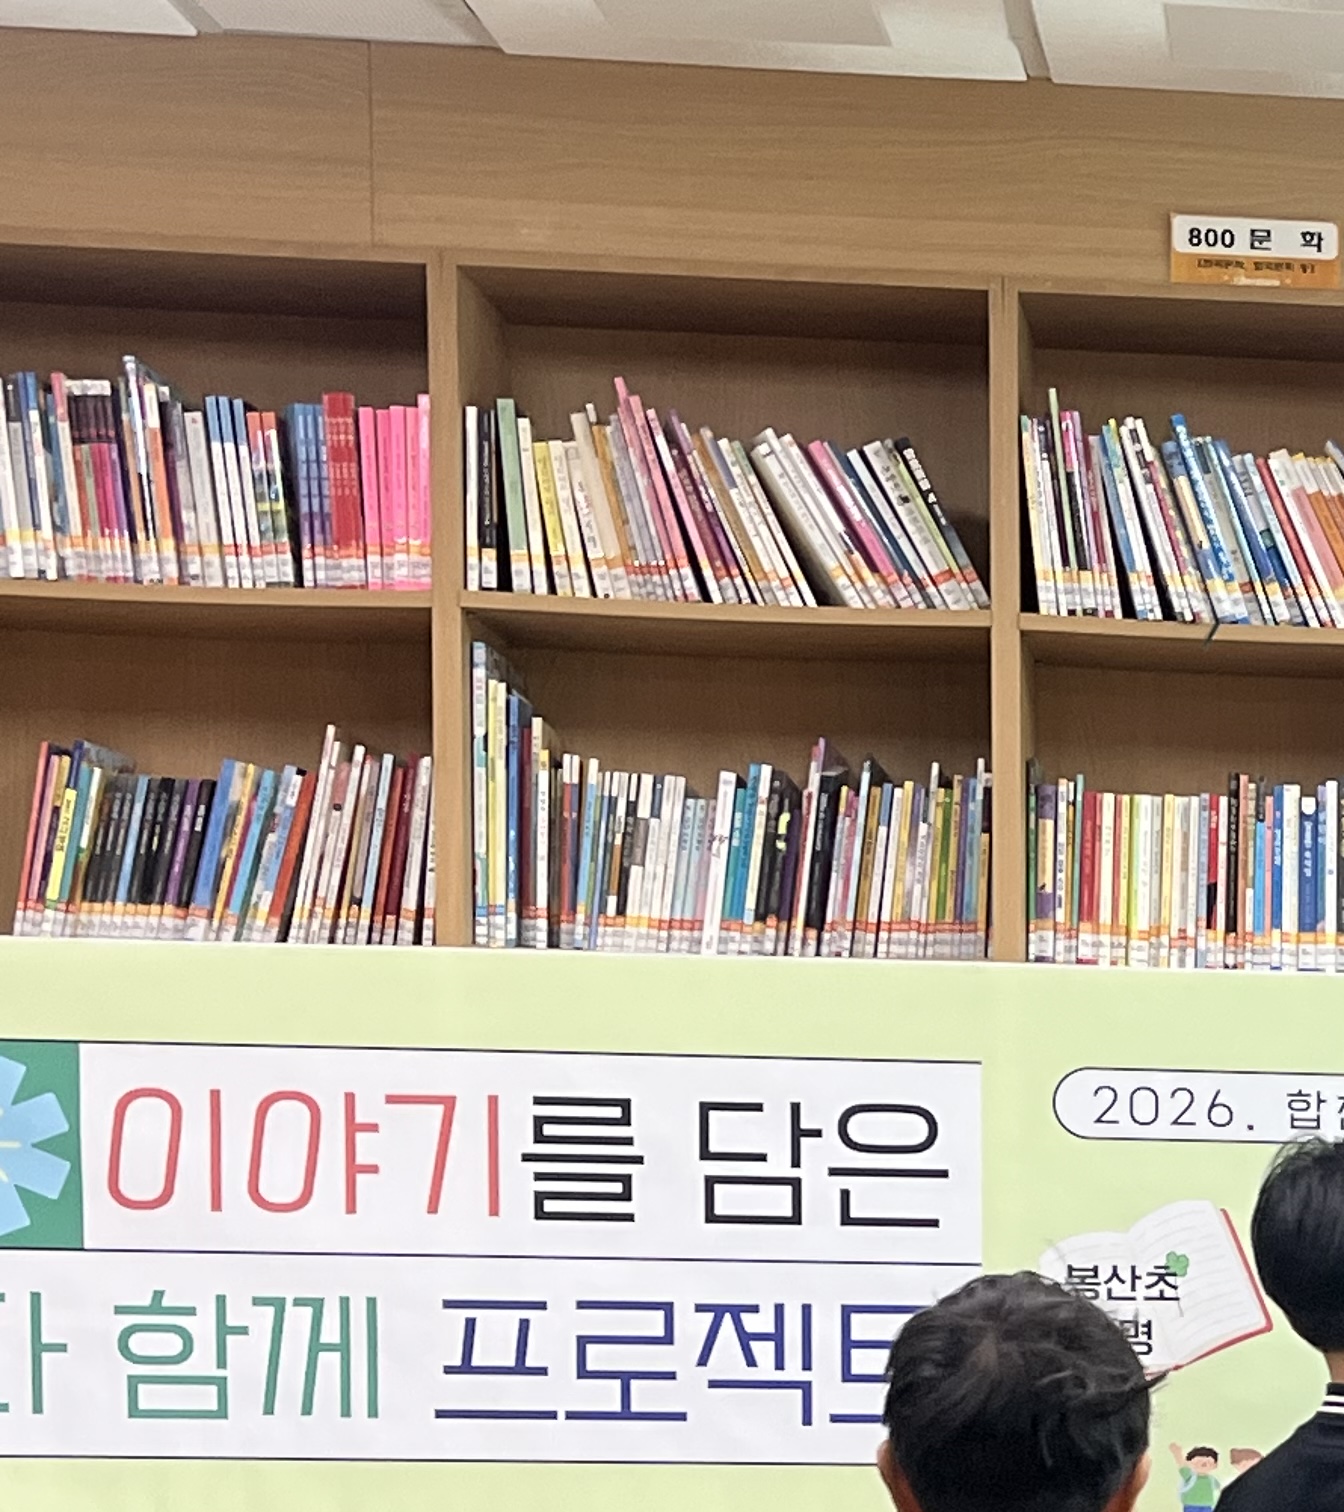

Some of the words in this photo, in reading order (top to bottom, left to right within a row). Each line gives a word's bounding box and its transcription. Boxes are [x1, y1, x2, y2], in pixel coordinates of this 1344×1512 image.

[1188, 227, 1235, 248] 800
[1249, 228, 1272, 250] 문
[1092, 1085, 1256, 1132] 2026.
[107, 1087, 645, 1223] 이야기를
[698, 1100, 950, 1229] 담은
[1064, 1263, 1181, 1301] 봉산초
[113, 1290, 380, 1422] 함께
